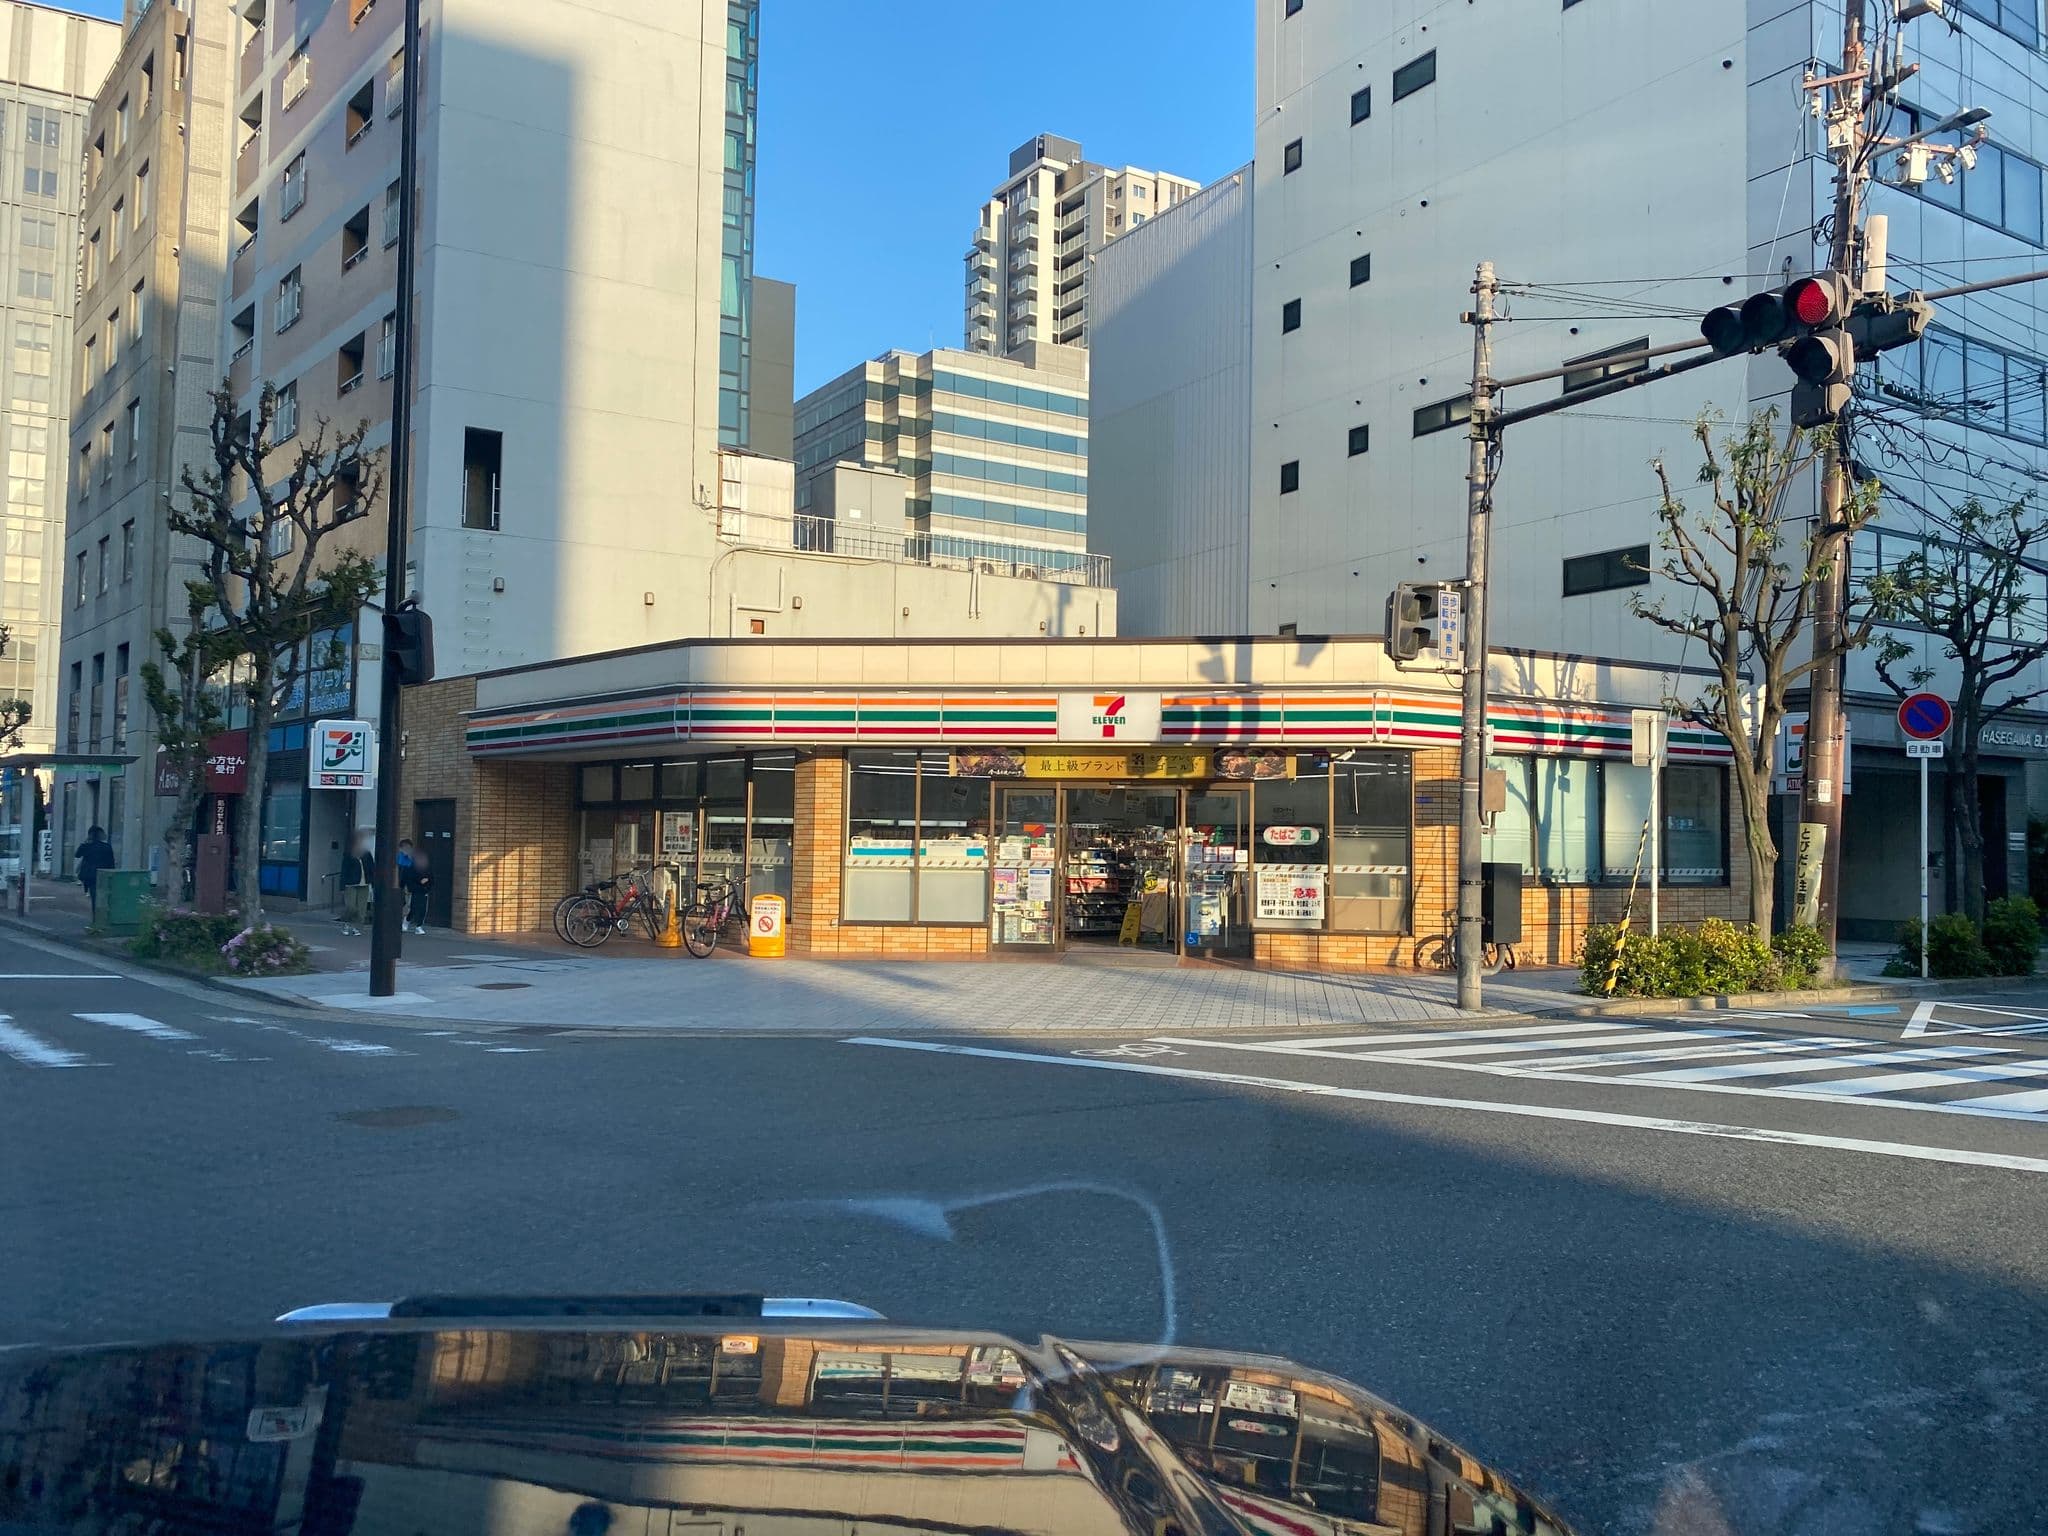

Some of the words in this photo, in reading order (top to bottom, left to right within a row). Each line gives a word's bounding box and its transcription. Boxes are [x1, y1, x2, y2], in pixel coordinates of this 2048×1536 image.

[1449, 596, 1457, 631] 歩行者
[1982, 730, 2031, 746] HASEGAWA
[1908, 745, 1941, 754] 自動車
[215, 766, 235, 775] 受付
[1040, 759, 1125, 772] 最上級ブランド
[350, 776, 363, 785] ATM
[1270, 829, 1296, 841] たばこ
